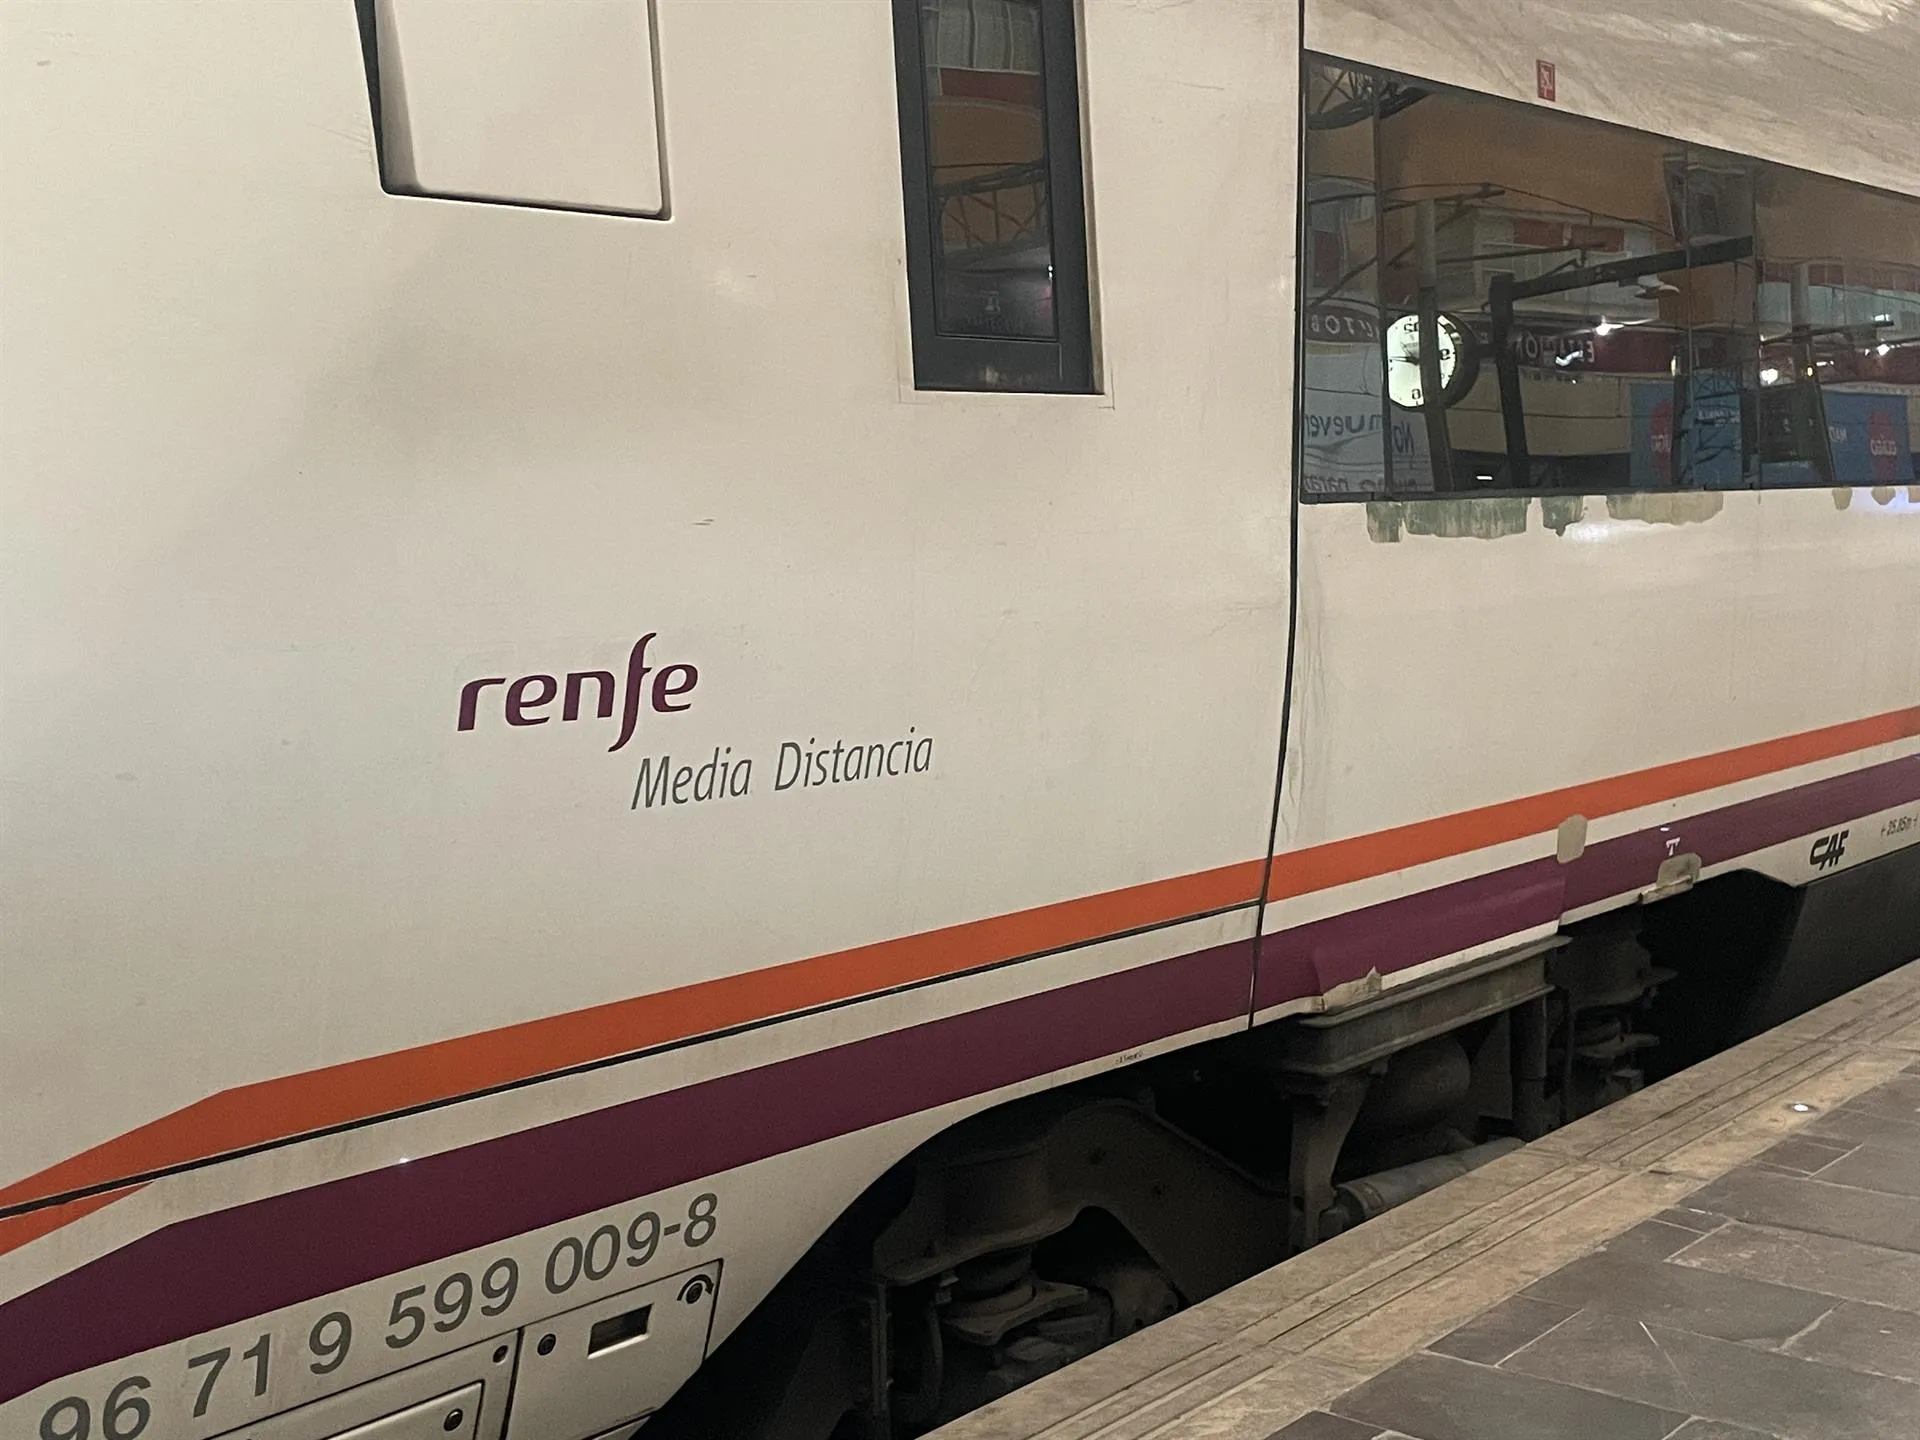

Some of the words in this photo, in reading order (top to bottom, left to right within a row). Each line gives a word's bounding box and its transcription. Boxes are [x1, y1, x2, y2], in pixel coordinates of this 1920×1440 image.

[457, 632, 699, 753] renfe
[631, 747, 752, 810] Media
[775, 726, 933, 791] Distancia
[1810, 829, 1849, 870] CAF
[39, 1375, 151, 1440] 96
[187, 1333, 272, 1419] 71
[308, 1311, 353, 1376] 9
[385, 1257, 519, 1351] 599
[544, 1192, 719, 1296] 009-8
